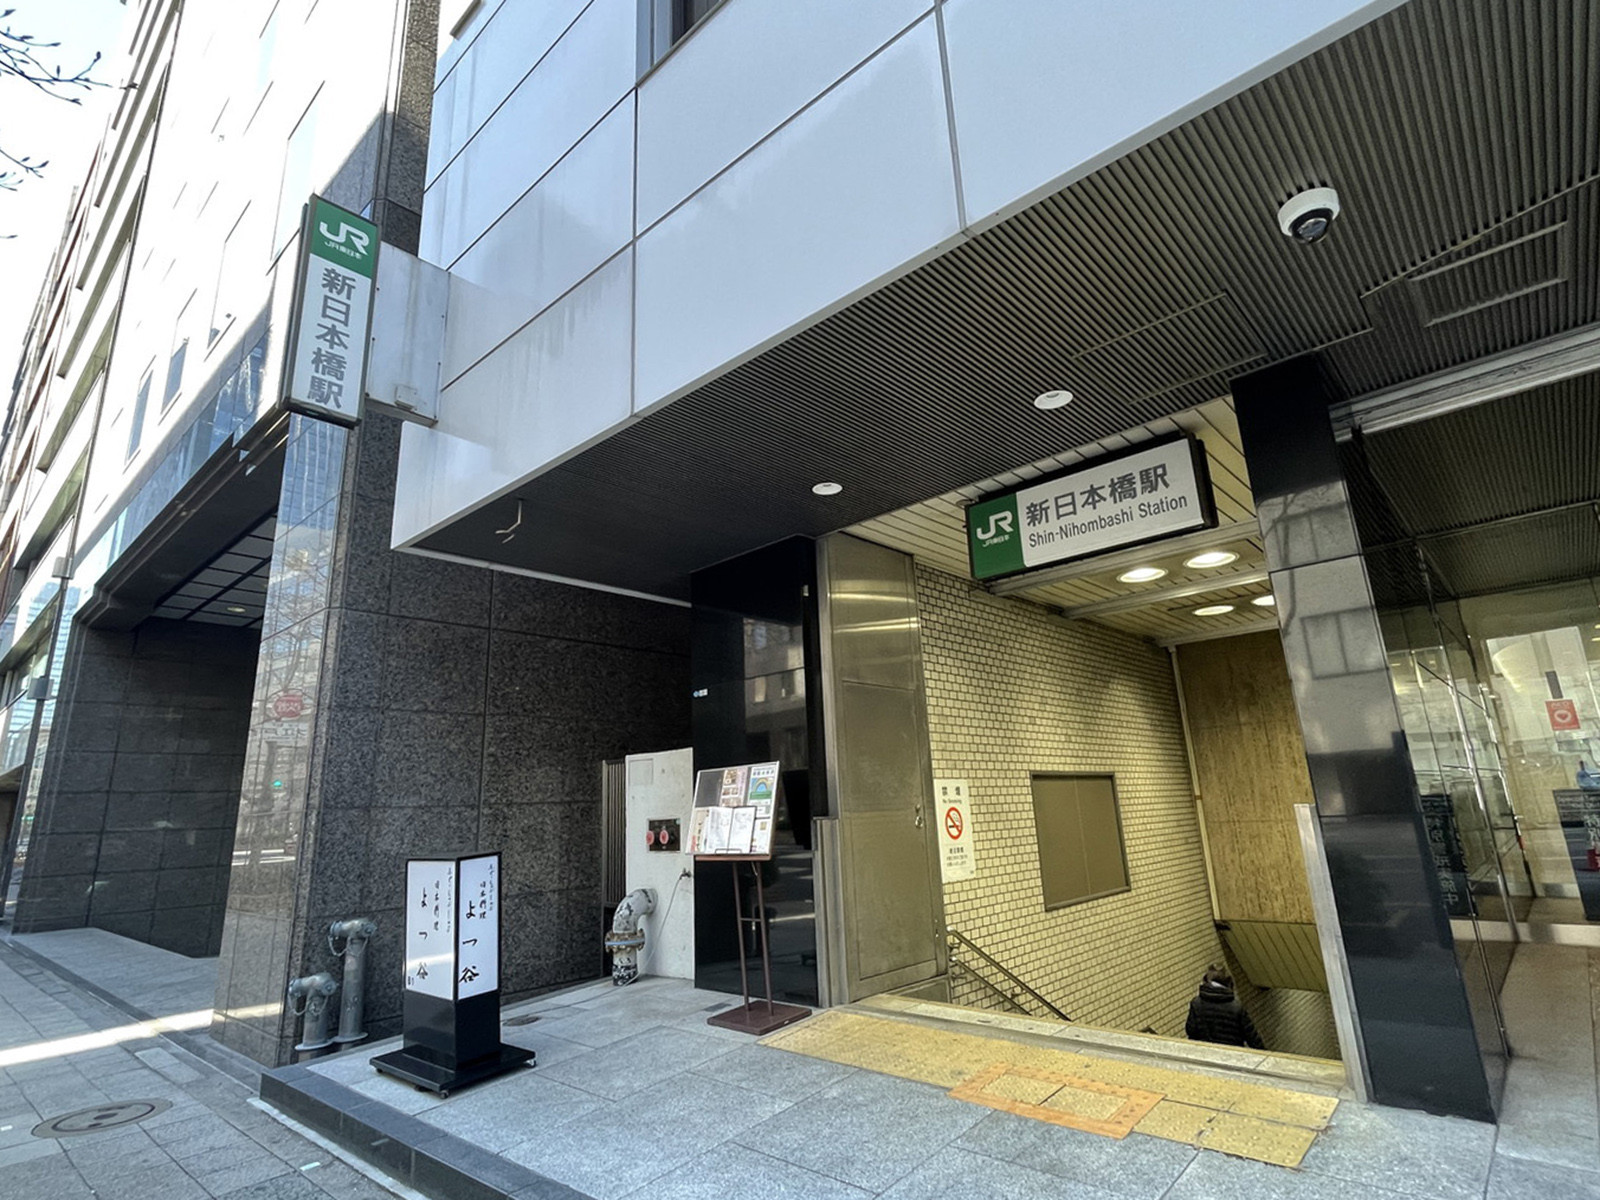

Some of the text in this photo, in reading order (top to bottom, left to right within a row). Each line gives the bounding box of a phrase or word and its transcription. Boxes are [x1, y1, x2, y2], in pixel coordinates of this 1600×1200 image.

[319, 221, 370, 256] JR
[307, 267, 357, 409] 新日本橋駅
[976, 511, 1014, 540] JR
[1025, 463, 1170, 527] 新日本橋駅
[1029, 494, 1188, 548] Shin-Nihombashi Station
[416, 887, 429, 980] よつ谷
[458, 901, 479, 982] よつ谷
